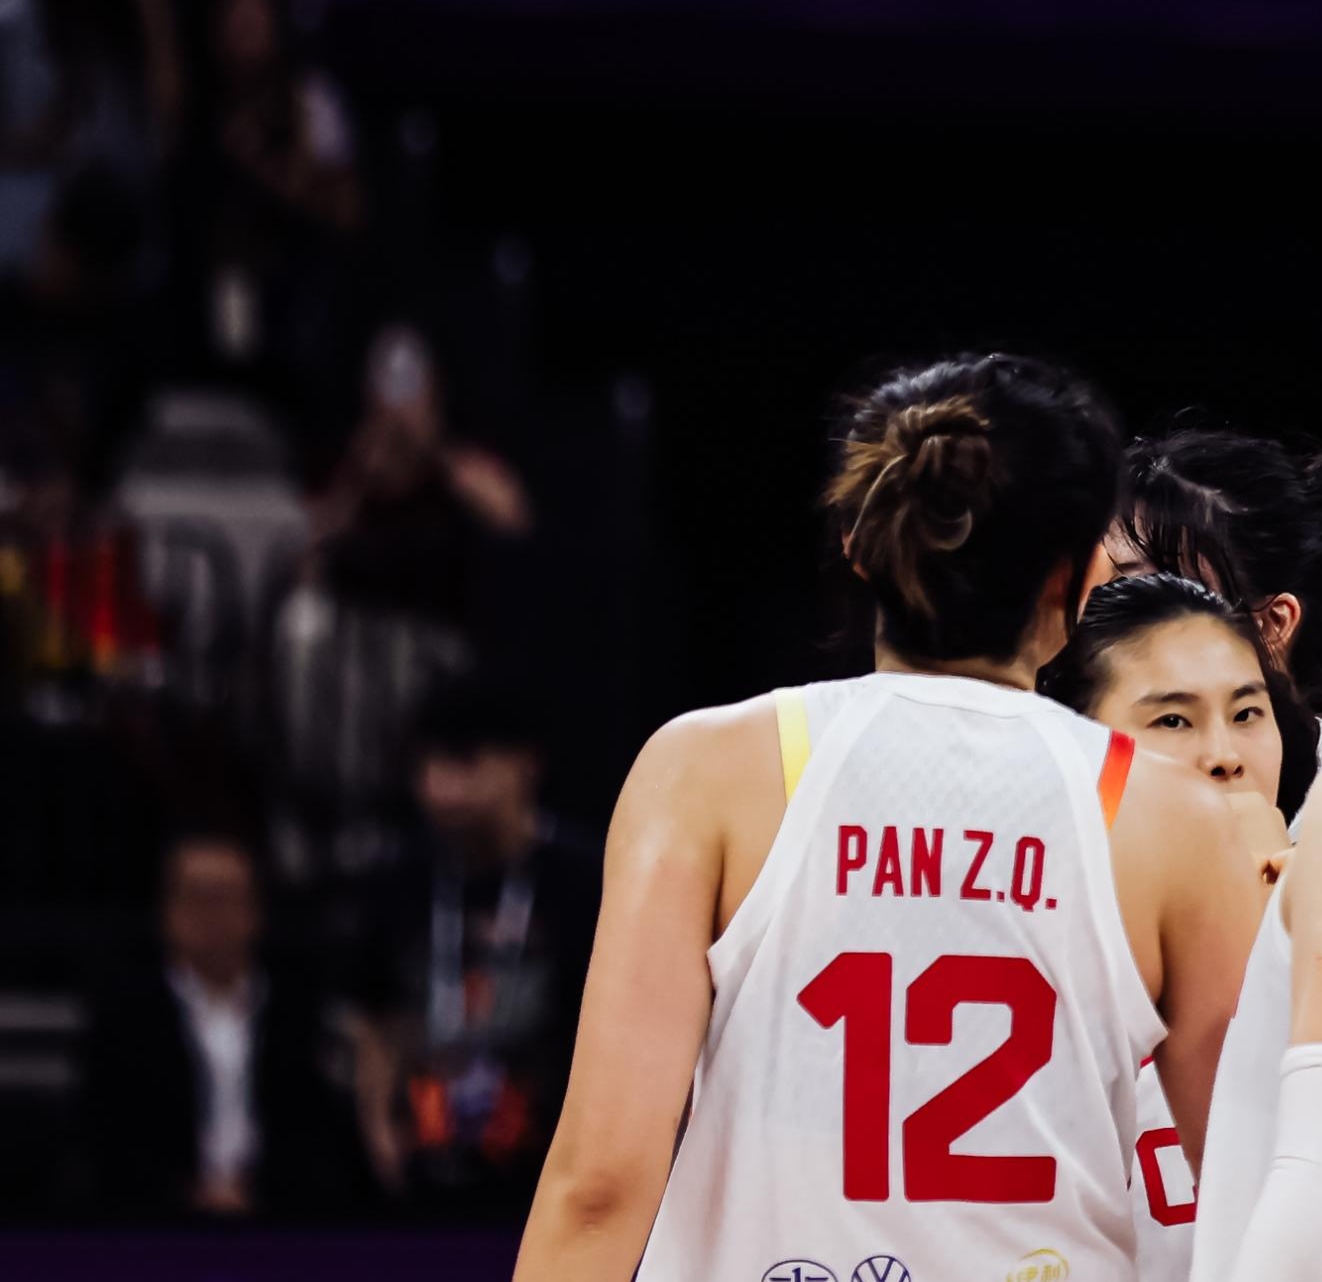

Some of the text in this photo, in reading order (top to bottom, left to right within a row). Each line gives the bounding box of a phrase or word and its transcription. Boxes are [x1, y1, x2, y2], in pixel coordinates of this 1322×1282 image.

[836, 824, 1058, 912] PAN Z.Q.
[796, 951, 1059, 1205] 12
